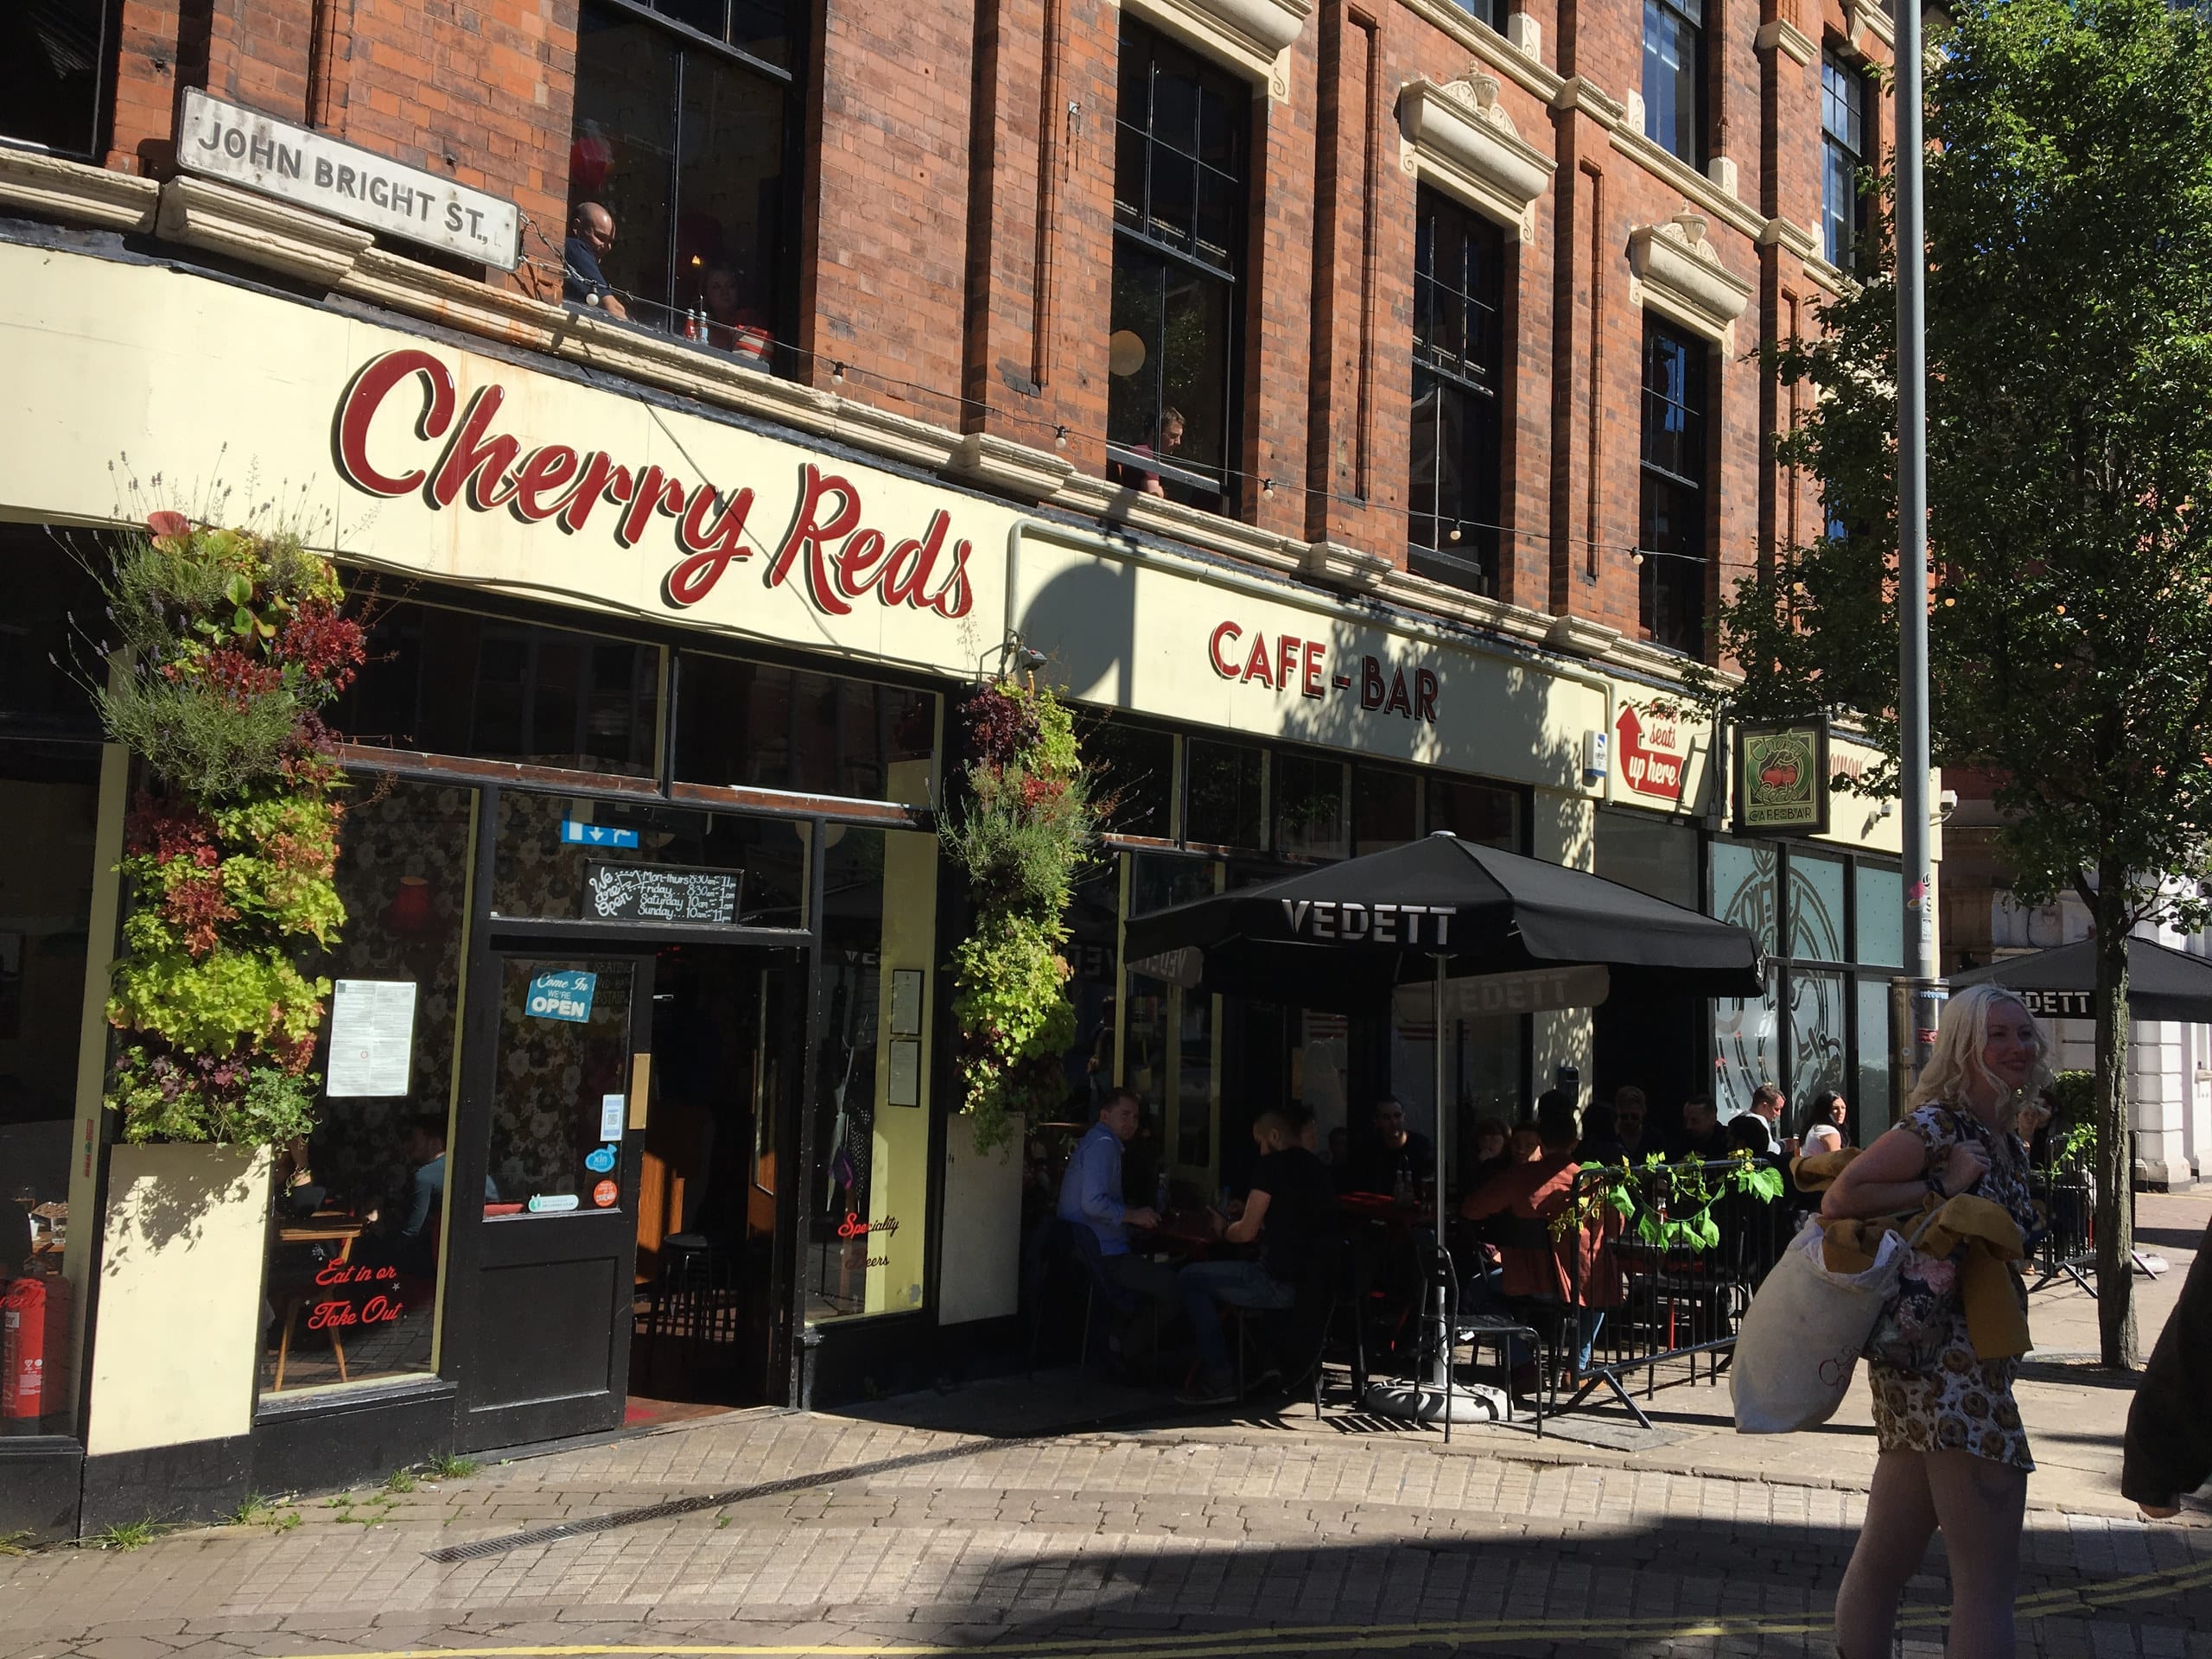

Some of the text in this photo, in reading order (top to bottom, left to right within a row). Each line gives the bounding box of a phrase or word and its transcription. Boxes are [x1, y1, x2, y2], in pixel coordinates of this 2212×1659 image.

[198, 121, 302, 179] JOHN
[314, 157, 435, 222] BRIGHT
[331, 349, 973, 619] Cherry Reds
[1649, 722, 1676, 750] seats
[1751, 737, 1805, 764] Cherry
[1628, 753, 1677, 790] up here
[1755, 779, 1800, 806] Reds
[588, 866, 613, 893] We
[594, 885, 620, 903] are
[639, 893, 684, 912] Saturday
[1281, 899, 1457, 945] VEDETT
[537, 972, 589, 991] Come In
[547, 989, 572, 1000] WE'RE
[531, 996, 586, 1017] OPEN
[2012, 991, 2091, 1014] DETT
[837, 1211, 899, 1239] Speciality
[315, 1257, 397, 1286] Eat in or
[308, 1295, 404, 1330] Take Out
